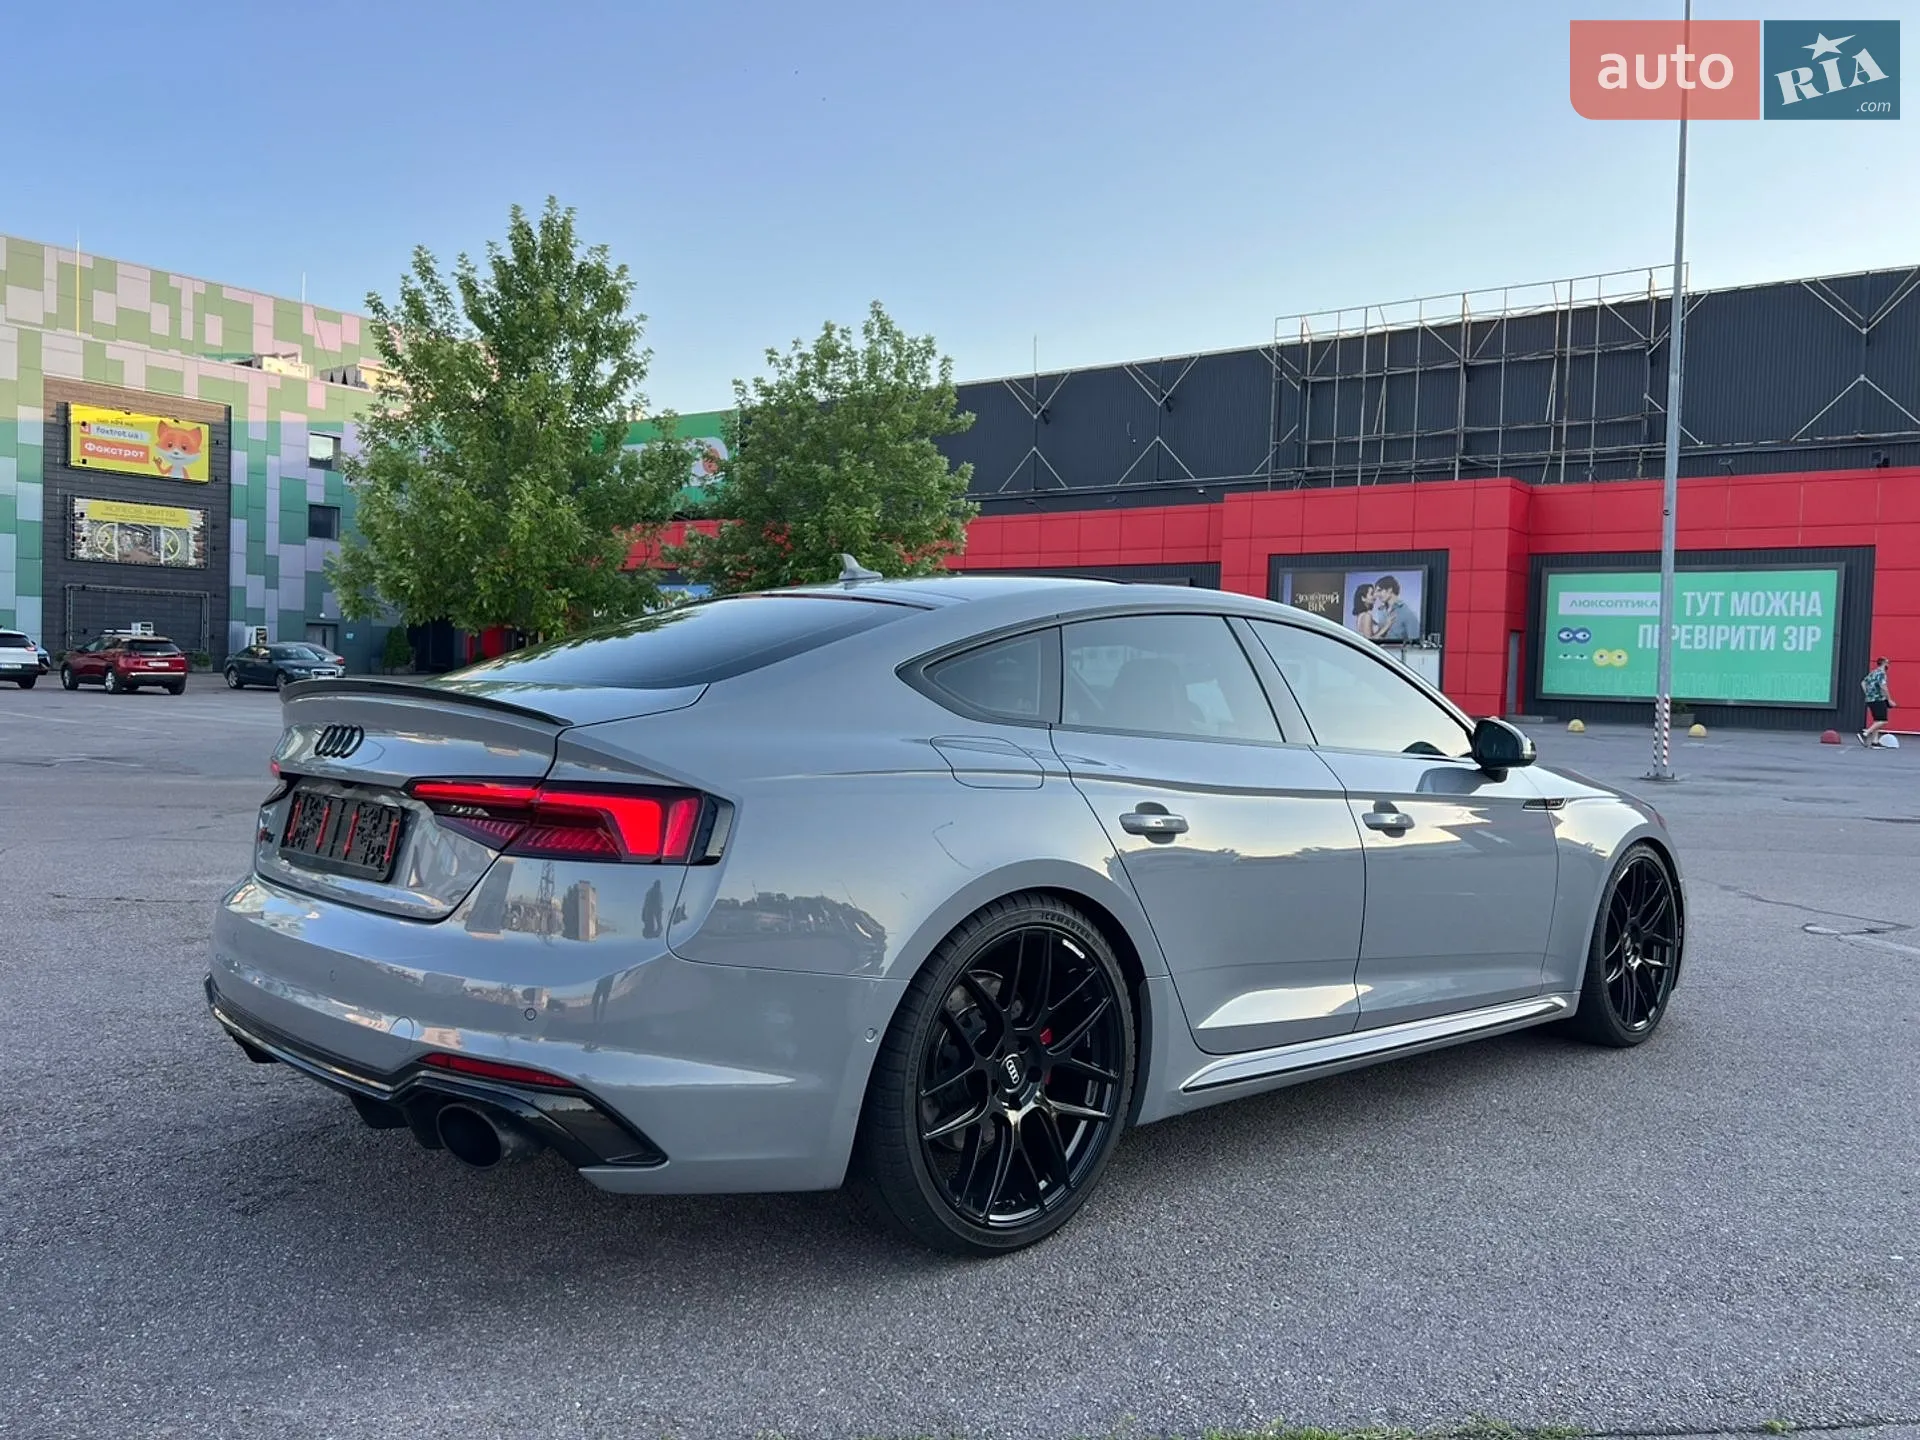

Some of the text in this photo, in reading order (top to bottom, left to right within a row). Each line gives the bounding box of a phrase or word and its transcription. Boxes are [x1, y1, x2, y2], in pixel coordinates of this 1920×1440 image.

[1569, 599, 1658, 608] ЛЮКСОПТИКА
[1683, 591, 1823, 617] ТУТ МОЖНА
[1782, 625, 1821, 651] ЗІР
